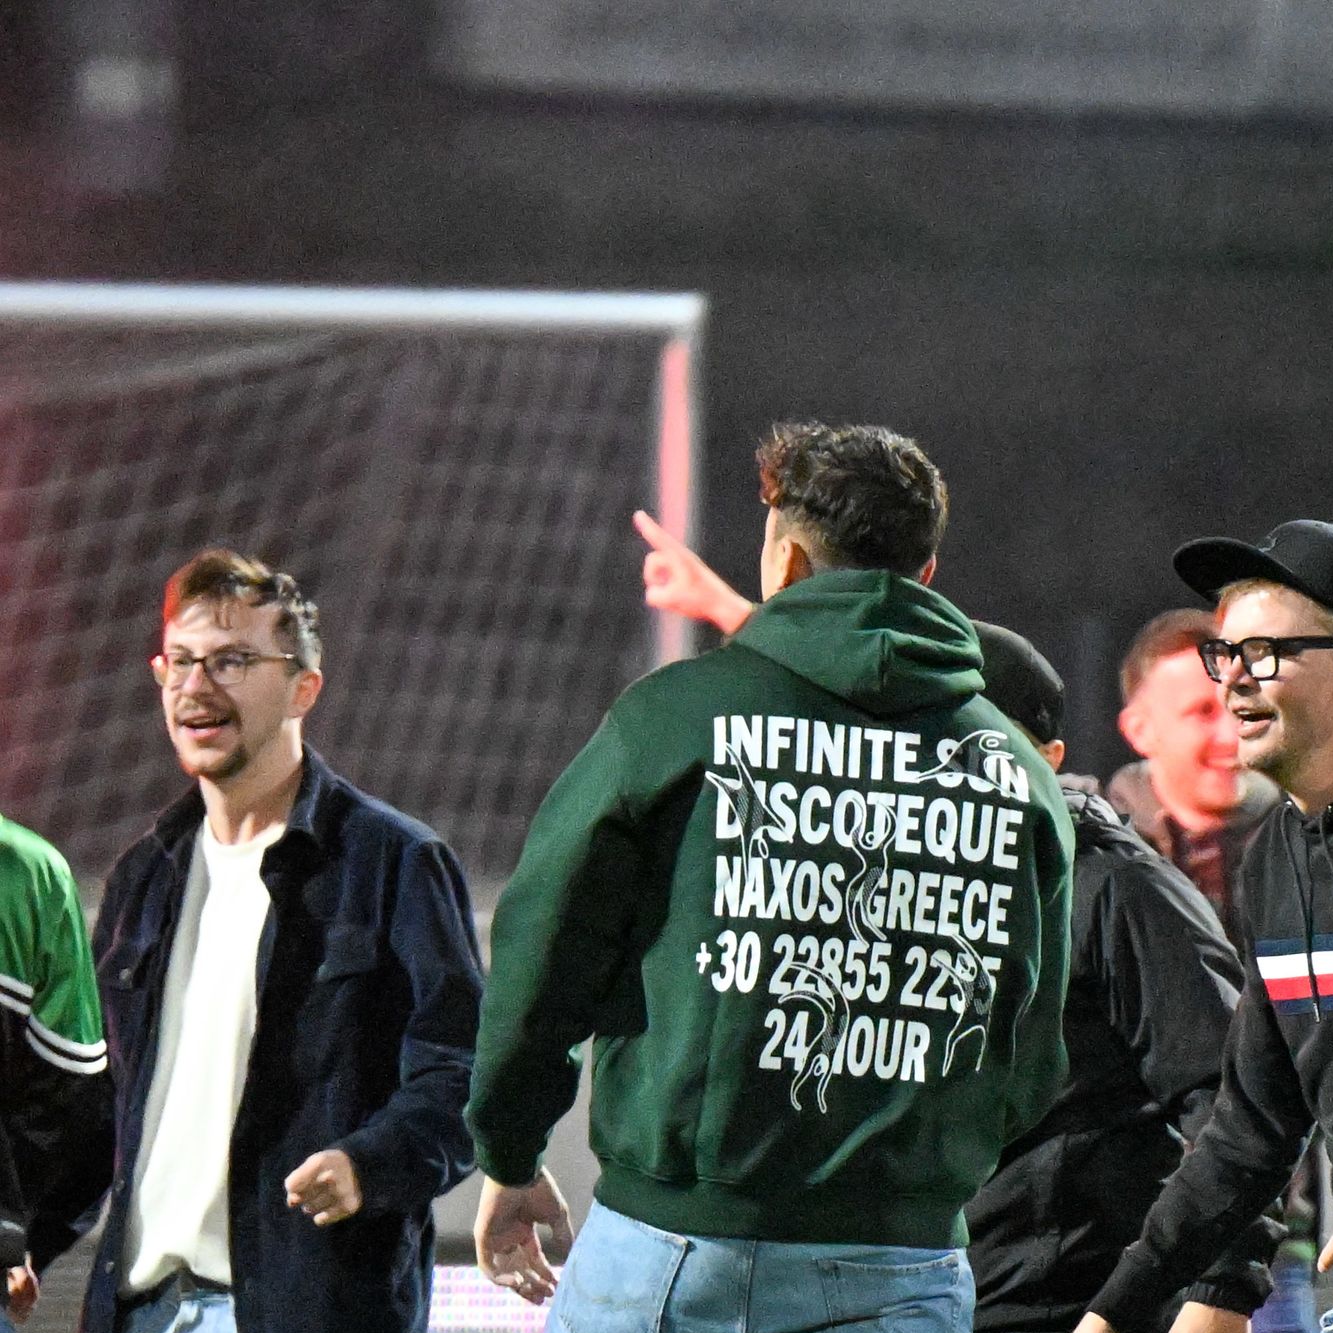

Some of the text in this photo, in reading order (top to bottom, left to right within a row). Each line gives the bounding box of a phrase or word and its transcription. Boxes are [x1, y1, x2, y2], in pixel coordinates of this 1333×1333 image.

[713, 714, 921, 784] INFINITE
[714, 777, 1024, 870] DISCOTEQUE
[713, 855, 1013, 945] NAXOS GREECE
[696, 929, 761, 993] +30
[768, 933, 892, 1003] 22855
[758, 1008, 810, 1073] 24
